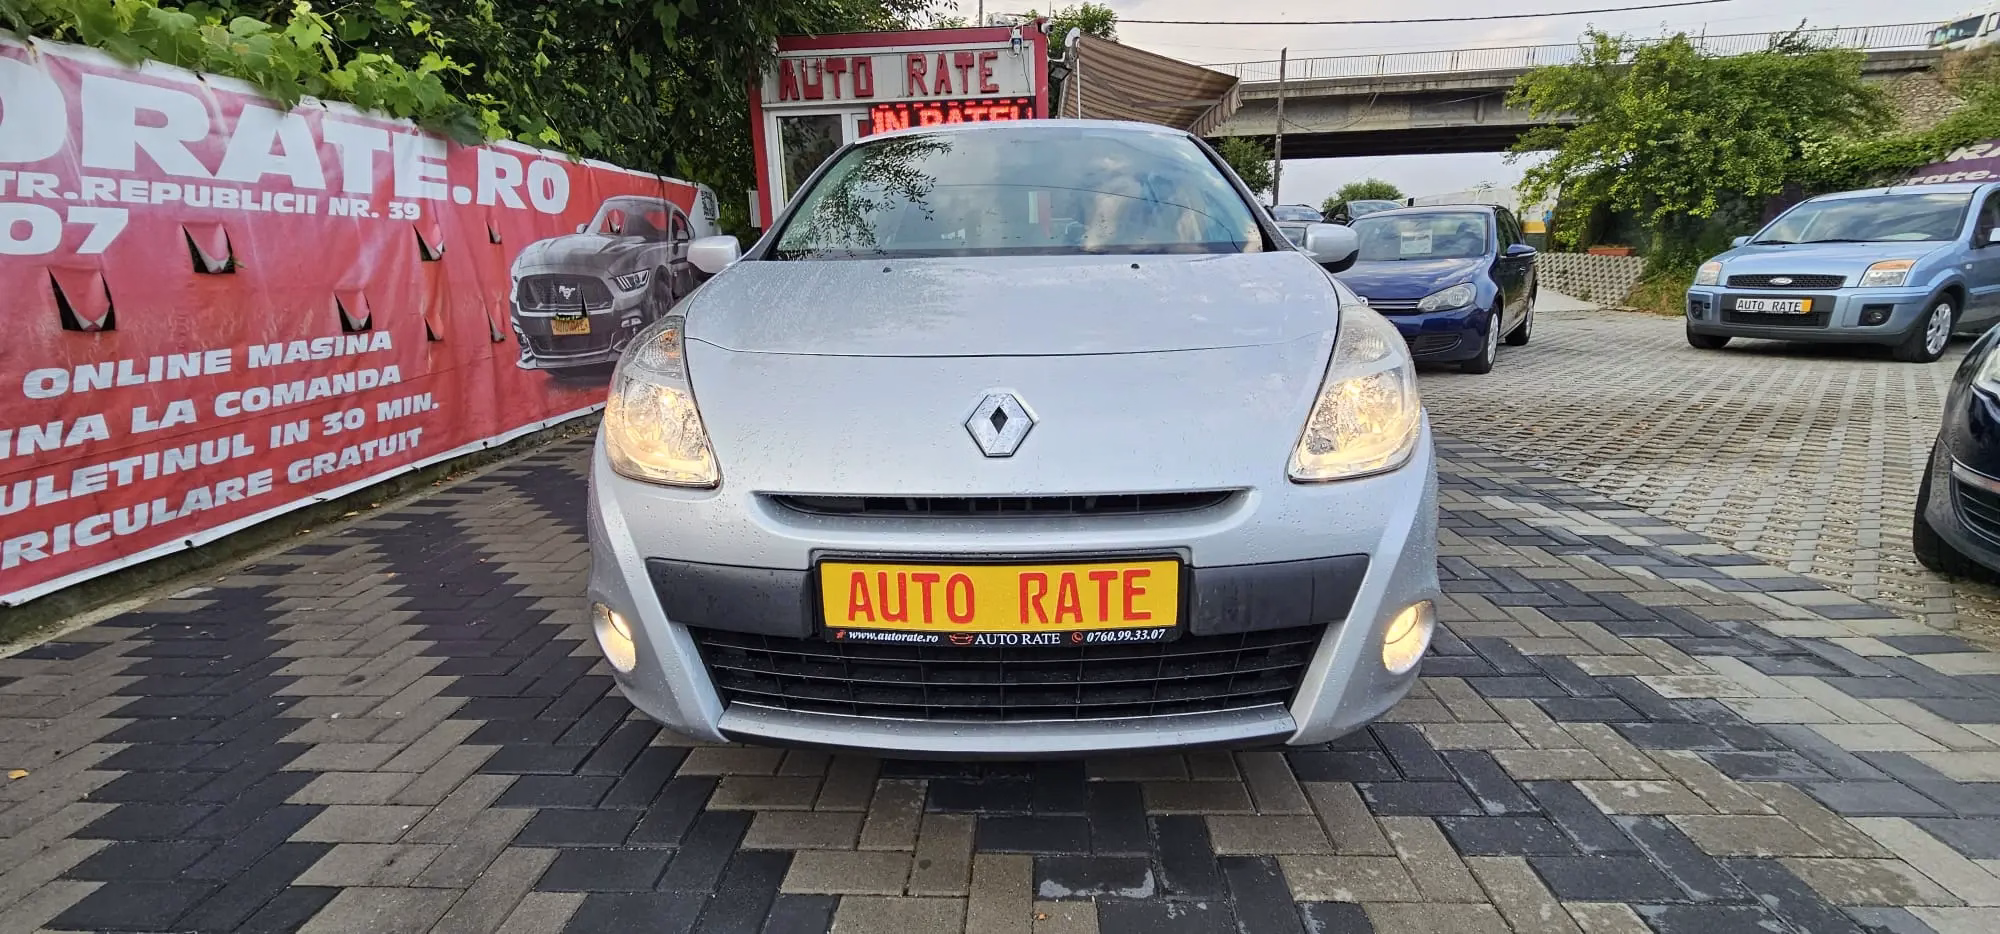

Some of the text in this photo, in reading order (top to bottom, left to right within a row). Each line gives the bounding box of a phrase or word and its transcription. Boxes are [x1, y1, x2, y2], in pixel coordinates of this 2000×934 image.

[779, 51, 999, 100] AUTO RATE
[328, 199, 379, 219] NR.
[388, 201, 421, 220] 39
[1737, 300, 1802, 312] AUTO RATE
[23, 330, 393, 400] ONLINE MASINA
[130, 399, 197, 434] LA
[213, 365, 402, 418] COMANDA
[268, 419, 310, 449] IN
[321, 406, 366, 436] 30
[376, 392, 439, 423] MIN.
[286, 427, 424, 484] GRATUIT
[847, 568, 1153, 625] AUTO RATE
[848, 629, 1166, 645] www.autorate.ro AUTO RATE 0760.99.33.07
